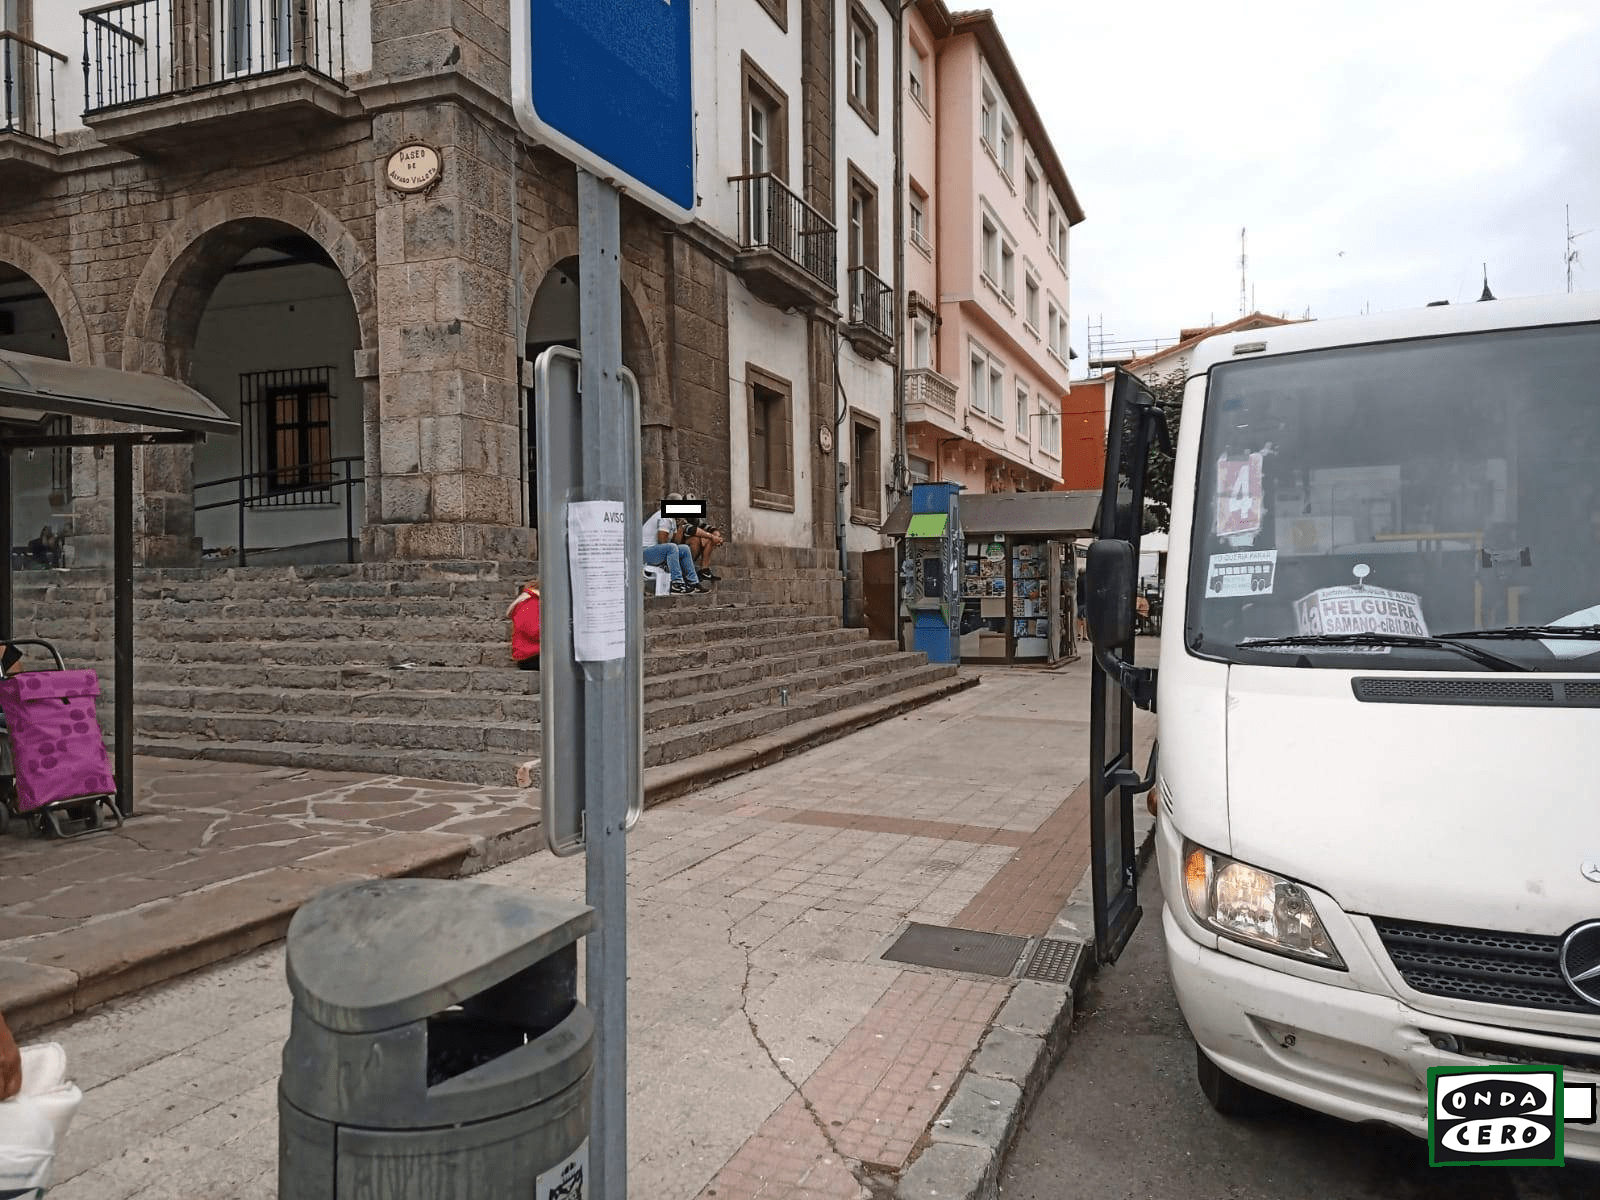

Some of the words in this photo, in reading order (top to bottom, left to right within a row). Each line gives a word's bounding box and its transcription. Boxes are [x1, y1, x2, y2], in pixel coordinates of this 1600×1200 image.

[400, 150, 425, 162] PASEO
[1230, 465, 1252, 519] 4
[1322, 599, 1418, 620] HELGUERA
